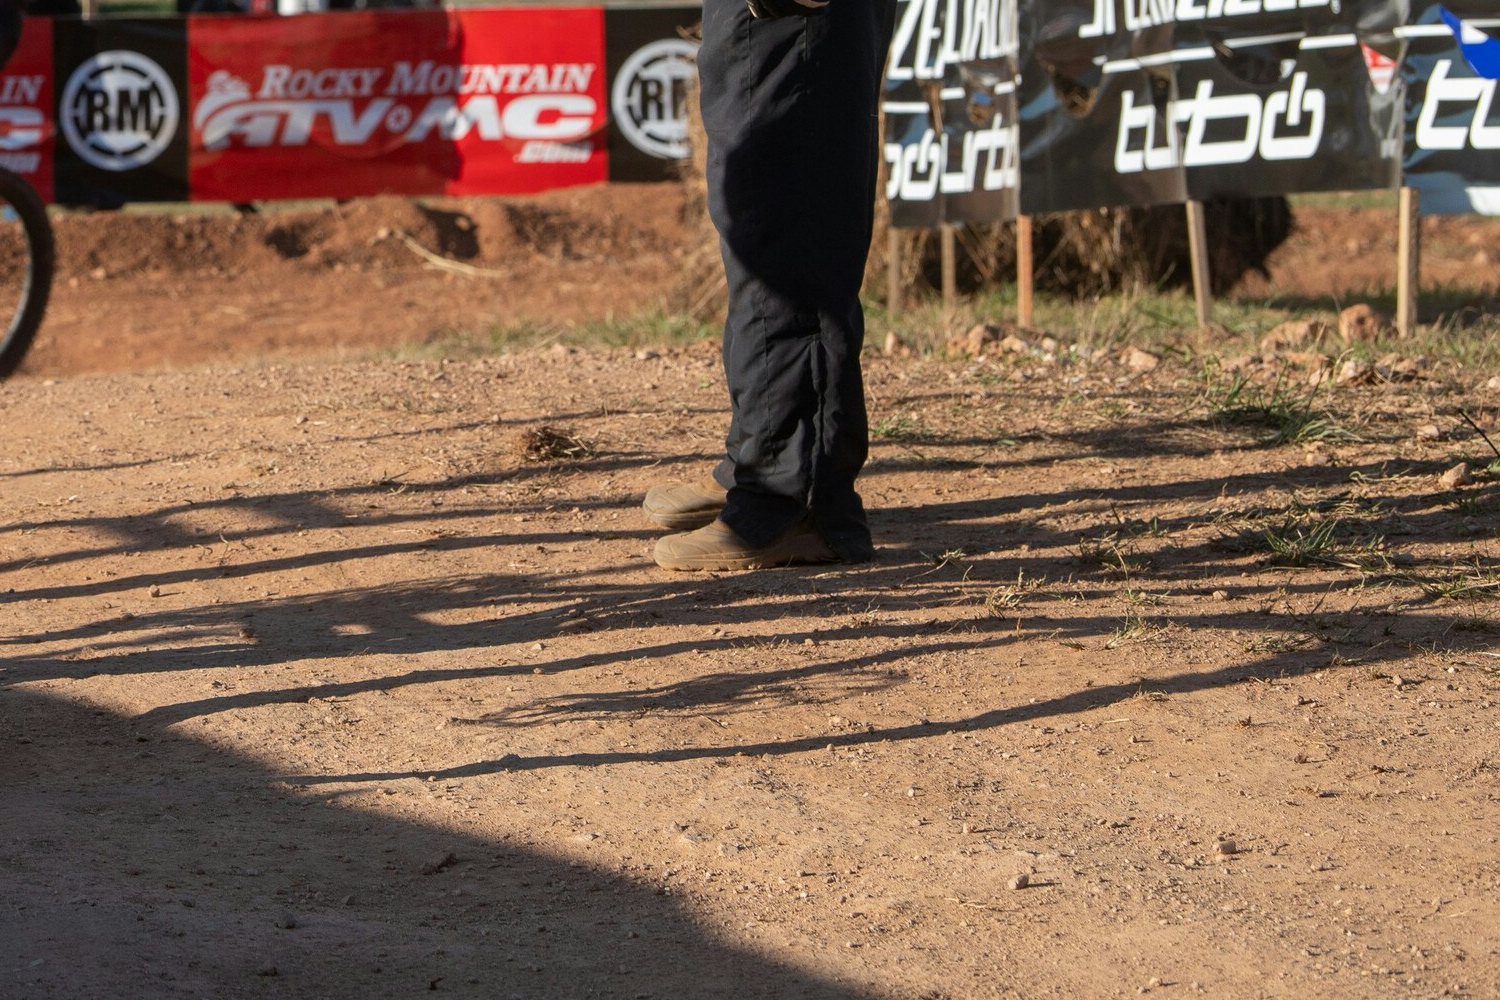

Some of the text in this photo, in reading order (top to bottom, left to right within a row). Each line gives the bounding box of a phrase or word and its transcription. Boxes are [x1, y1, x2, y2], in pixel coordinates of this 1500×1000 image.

[256, 60, 596, 98] ROCKY MOUNTAIN
[87, 89, 150, 133] RM
